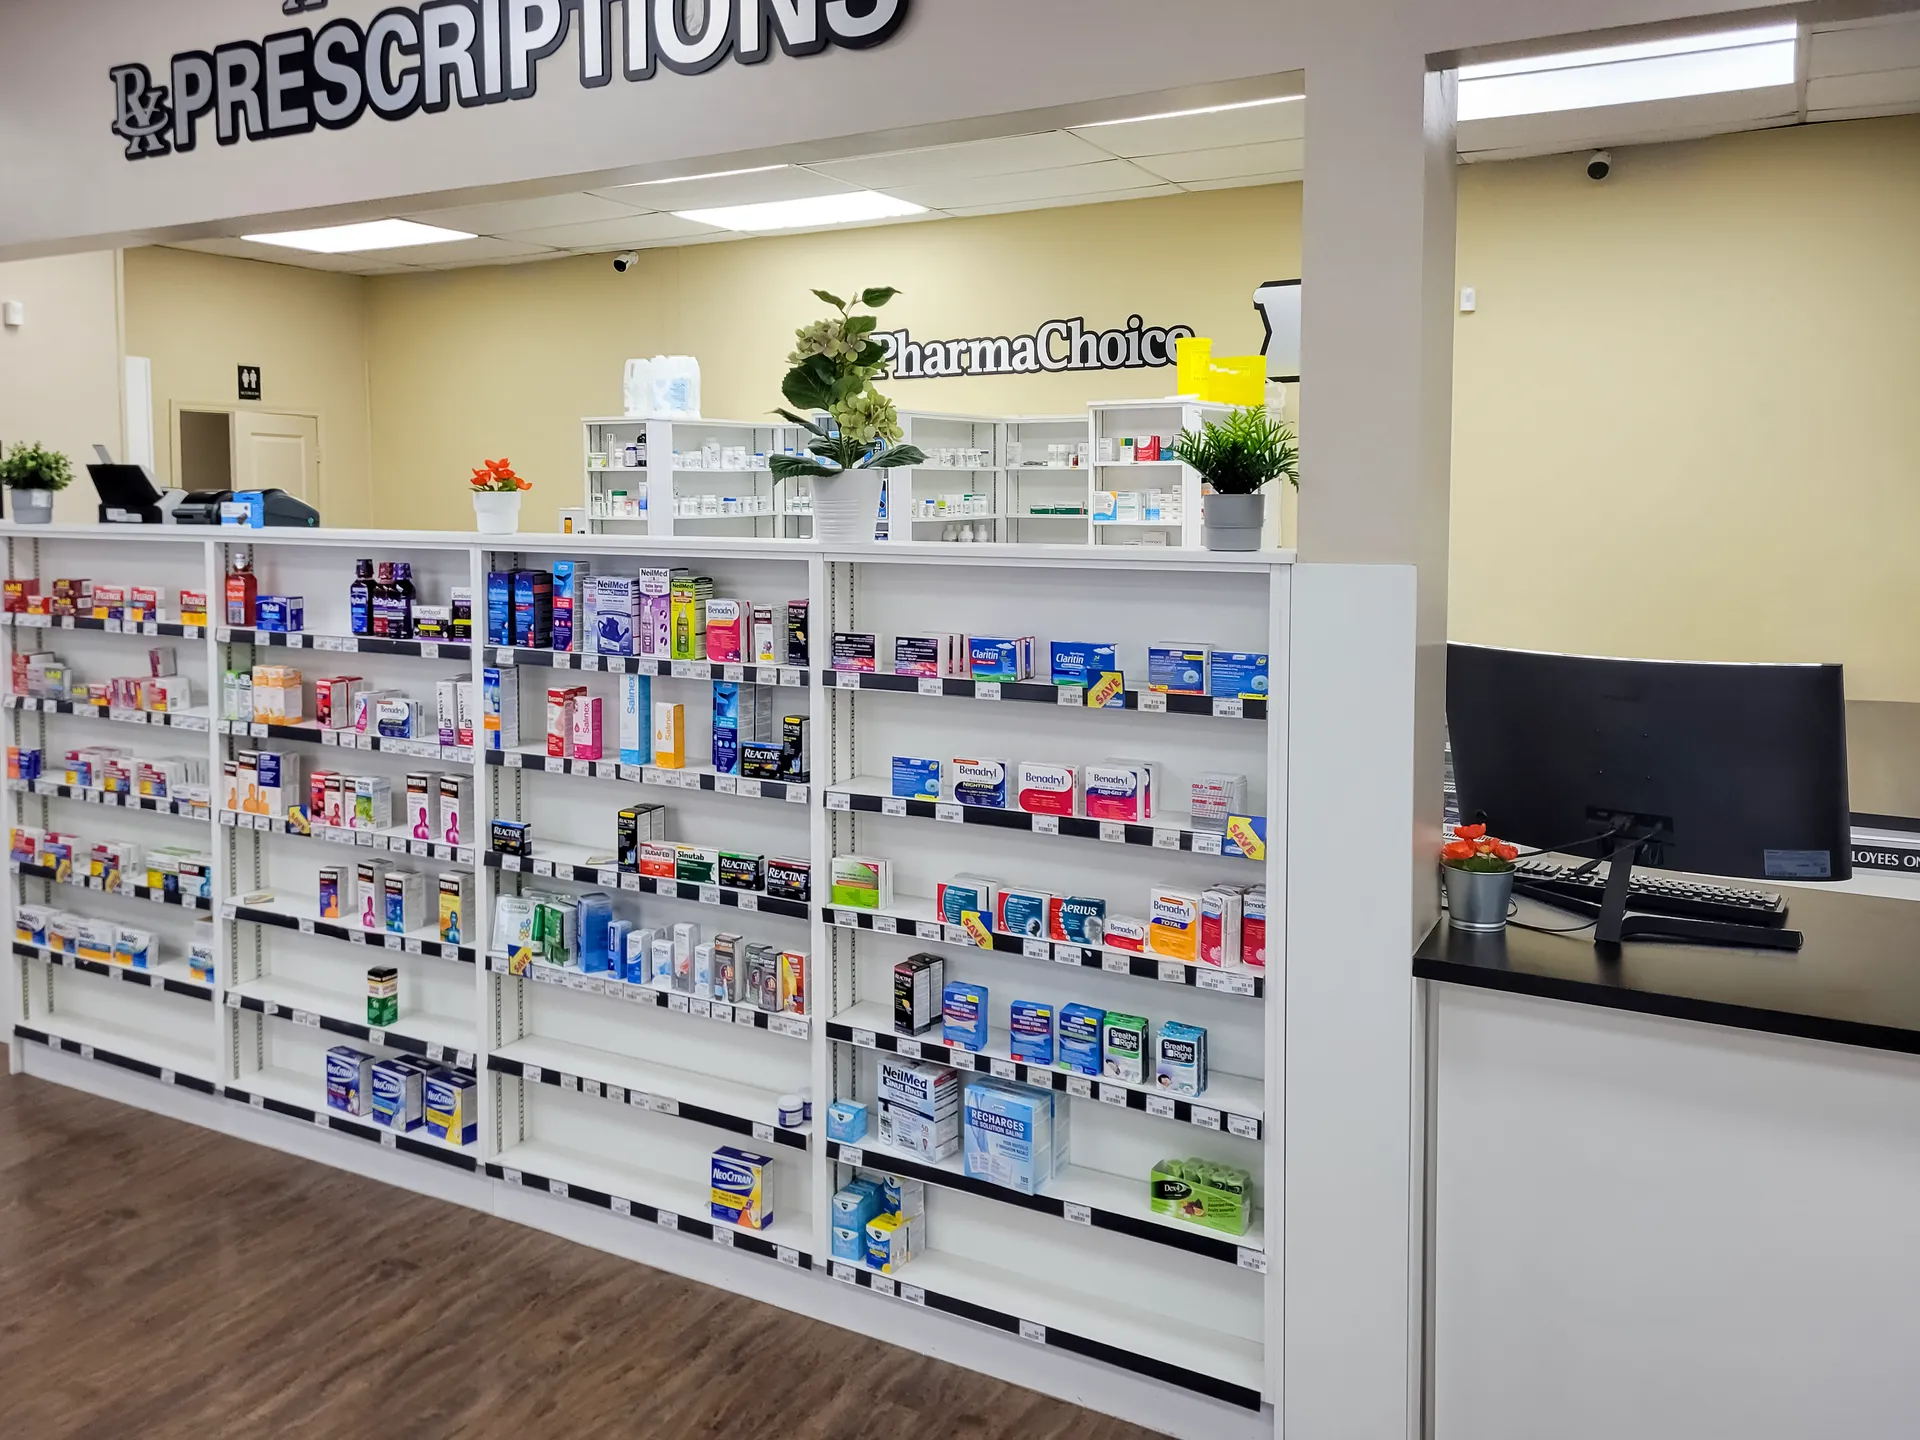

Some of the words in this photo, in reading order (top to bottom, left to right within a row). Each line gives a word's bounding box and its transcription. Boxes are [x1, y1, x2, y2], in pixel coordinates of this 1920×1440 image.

[868, 314, 1194, 379] PharmaChoice
[641, 569, 668, 577] NeilMed
[597, 580, 629, 589] NeilMed
[708, 605, 735, 617] Benadryl
[972, 649, 998, 660] Claritin
[1056, 653, 1084, 664] Claritin
[627, 676, 637, 714] Salinex
[1095, 678, 1121, 705] SAVE
[744, 748, 781, 761] REACTINE
[960, 765, 997, 779] Benadryl
[1025, 772, 1064, 786] Benadryl
[1094, 773, 1128, 786] Benadryl
[494, 826, 521, 838] REACTINE
[1229, 824, 1257, 856] SAVE
[677, 850, 704, 860] Sinutab
[1852, 850, 1899, 866] LOYEES
[721, 858, 757, 871] REACTINE
[768, 867, 808, 882] REACTINE
[1153, 900, 1190, 917] Benadryl
[1110, 923, 1137, 936] Benadryl
[1160, 919, 1182, 928] TOTAL
[963, 918, 987, 946] SAVE
[514, 953, 530, 973] SAVE
[1110, 1029, 1138, 1042] Breathe
[1120, 1037, 1138, 1049] Right
[1164, 1041, 1193, 1053] Breathe
[1173, 1049, 1194, 1061] Right
[883, 1065, 928, 1089] NeilMed
[885, 1079, 904, 1091] SINUS
[905, 1085, 924, 1099] RINSE
[971, 1109, 1025, 1132] RECHARGES
[921, 1124, 929, 1133] 50
[980, 1122, 1004, 1134] SOLUTION
[1005, 1128, 1024, 1139] SALINE
